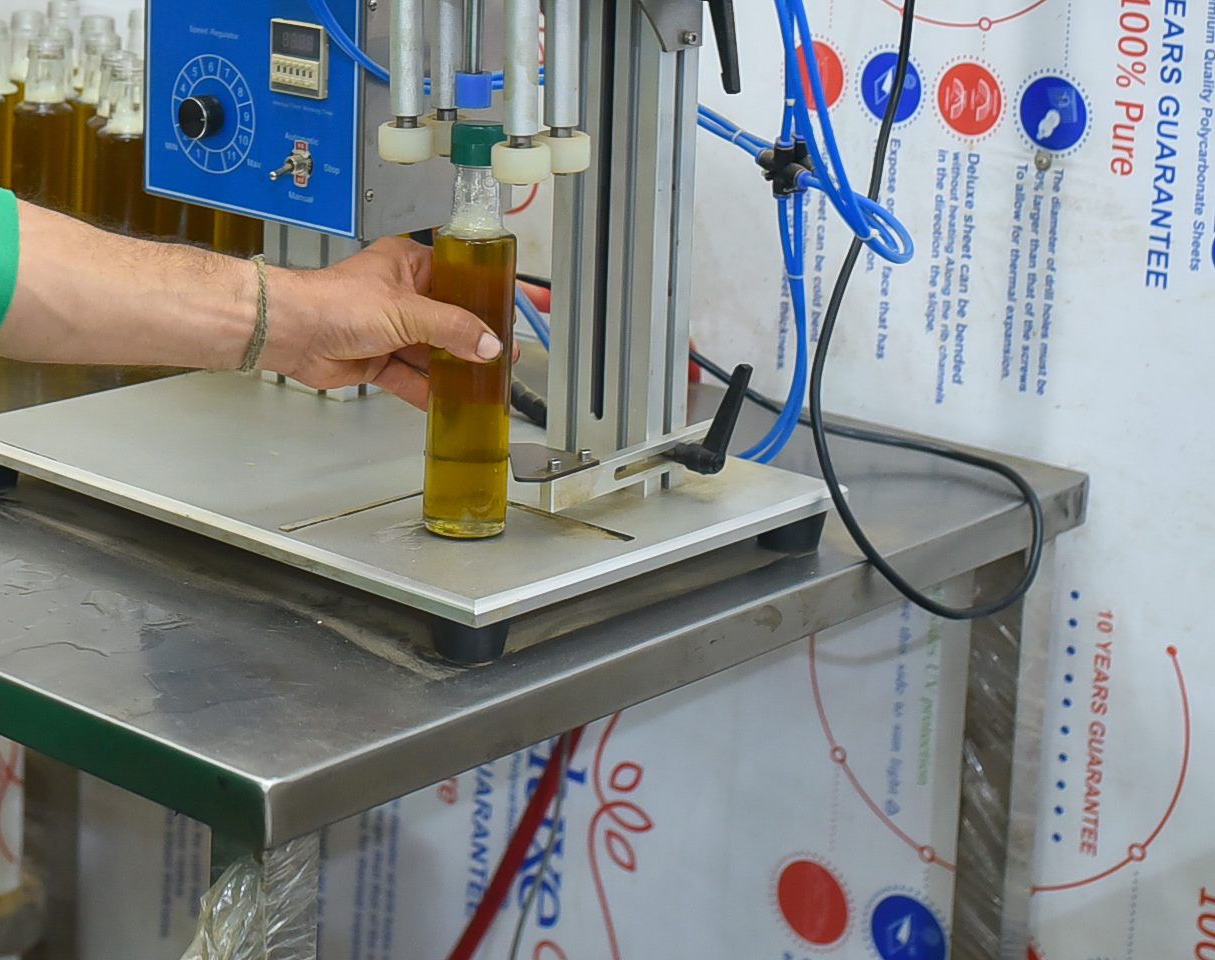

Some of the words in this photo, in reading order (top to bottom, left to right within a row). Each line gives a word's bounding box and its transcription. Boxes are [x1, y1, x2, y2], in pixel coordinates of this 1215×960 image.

[192, 67, 198, 76] 5
[208, 62, 214, 72] 6
[225, 68, 230, 76] 7
[1199, 49, 1215, 102] Quality
[238, 87, 244, 97] 8
[244, 112, 250, 122] 9
[238, 136, 248, 145] 10
[1111, 100, 1144, 176] Pure
[196, 148, 200, 158] 1
[227, 151, 236, 160] 11
[1194, 107, 1212, 216] Polycarbonate
[324, 164, 340, 174] Stop
[965, 153, 980, 209] Deluxe
[288, 191, 314, 204] Manual
[1146, 96, 1180, 289] GUARANTEE
[961, 215, 976, 260] sheet
[1190, 220, 1205, 271] Sheets
[881, 266, 892, 296] face
[959, 264, 969, 293] can
[878, 302, 890, 330] that
[957, 298, 970, 318] be
[876, 334, 888, 359] has
[952, 323, 968, 385] bended
[1097, 611, 1114, 633] 10
[1090, 642, 1112, 715] YEARS
[1080, 721, 1106, 856] GUARANTEE
[517, 744, 588, 929] luxe
